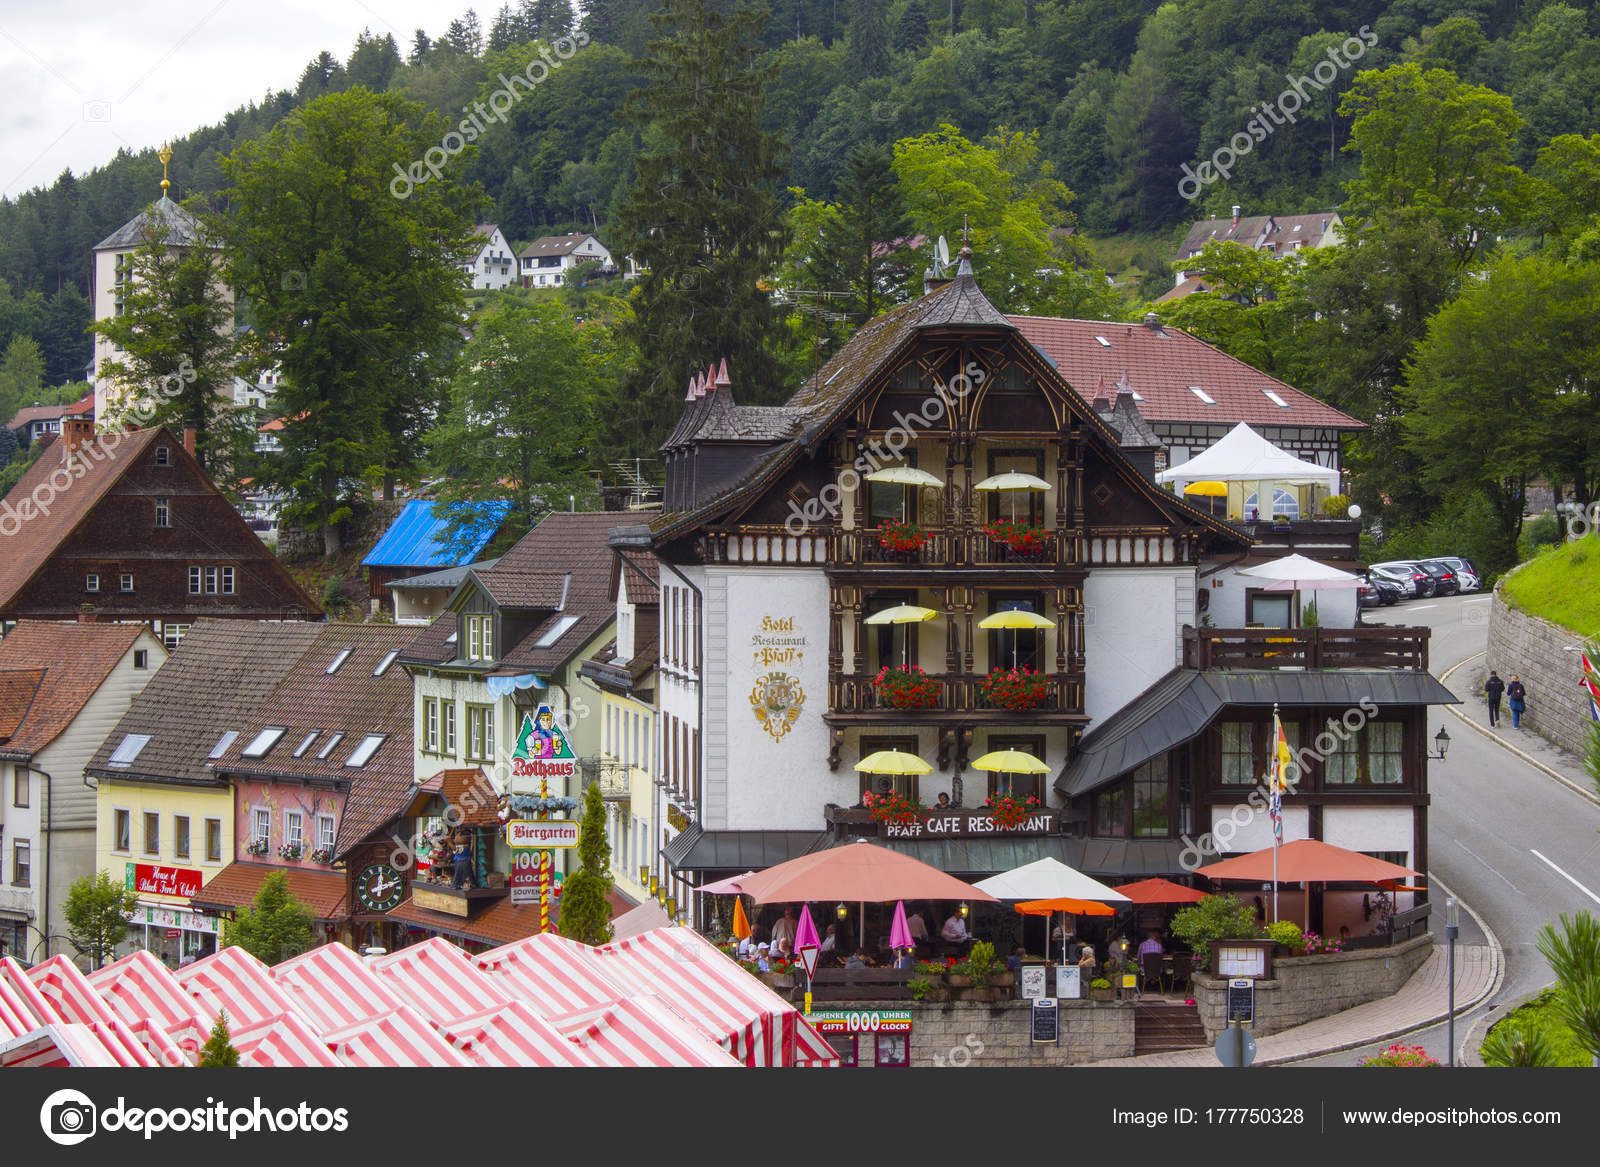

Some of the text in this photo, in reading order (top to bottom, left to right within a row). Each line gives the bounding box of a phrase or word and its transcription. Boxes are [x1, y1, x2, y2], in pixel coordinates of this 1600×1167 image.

[762, 615, 795, 631] Hotel
[752, 634, 806, 646] Restaurant
[760, 647, 796, 667] Pfaff
[512, 758, 574, 779] Rothaus
[513, 825, 576, 840] Biergarten
[887, 825, 923, 837] PFAFF
[926, 817, 961, 833] CAFE
[152, 865, 168, 879] House
[170, 869, 178, 885] of
[513, 888, 552, 896] SOUVENS
[822, 1023, 844, 1031] GIFTS
[881, 1023, 910, 1031] CLOCKS
[845, 1012, 881, 1032] 1000
